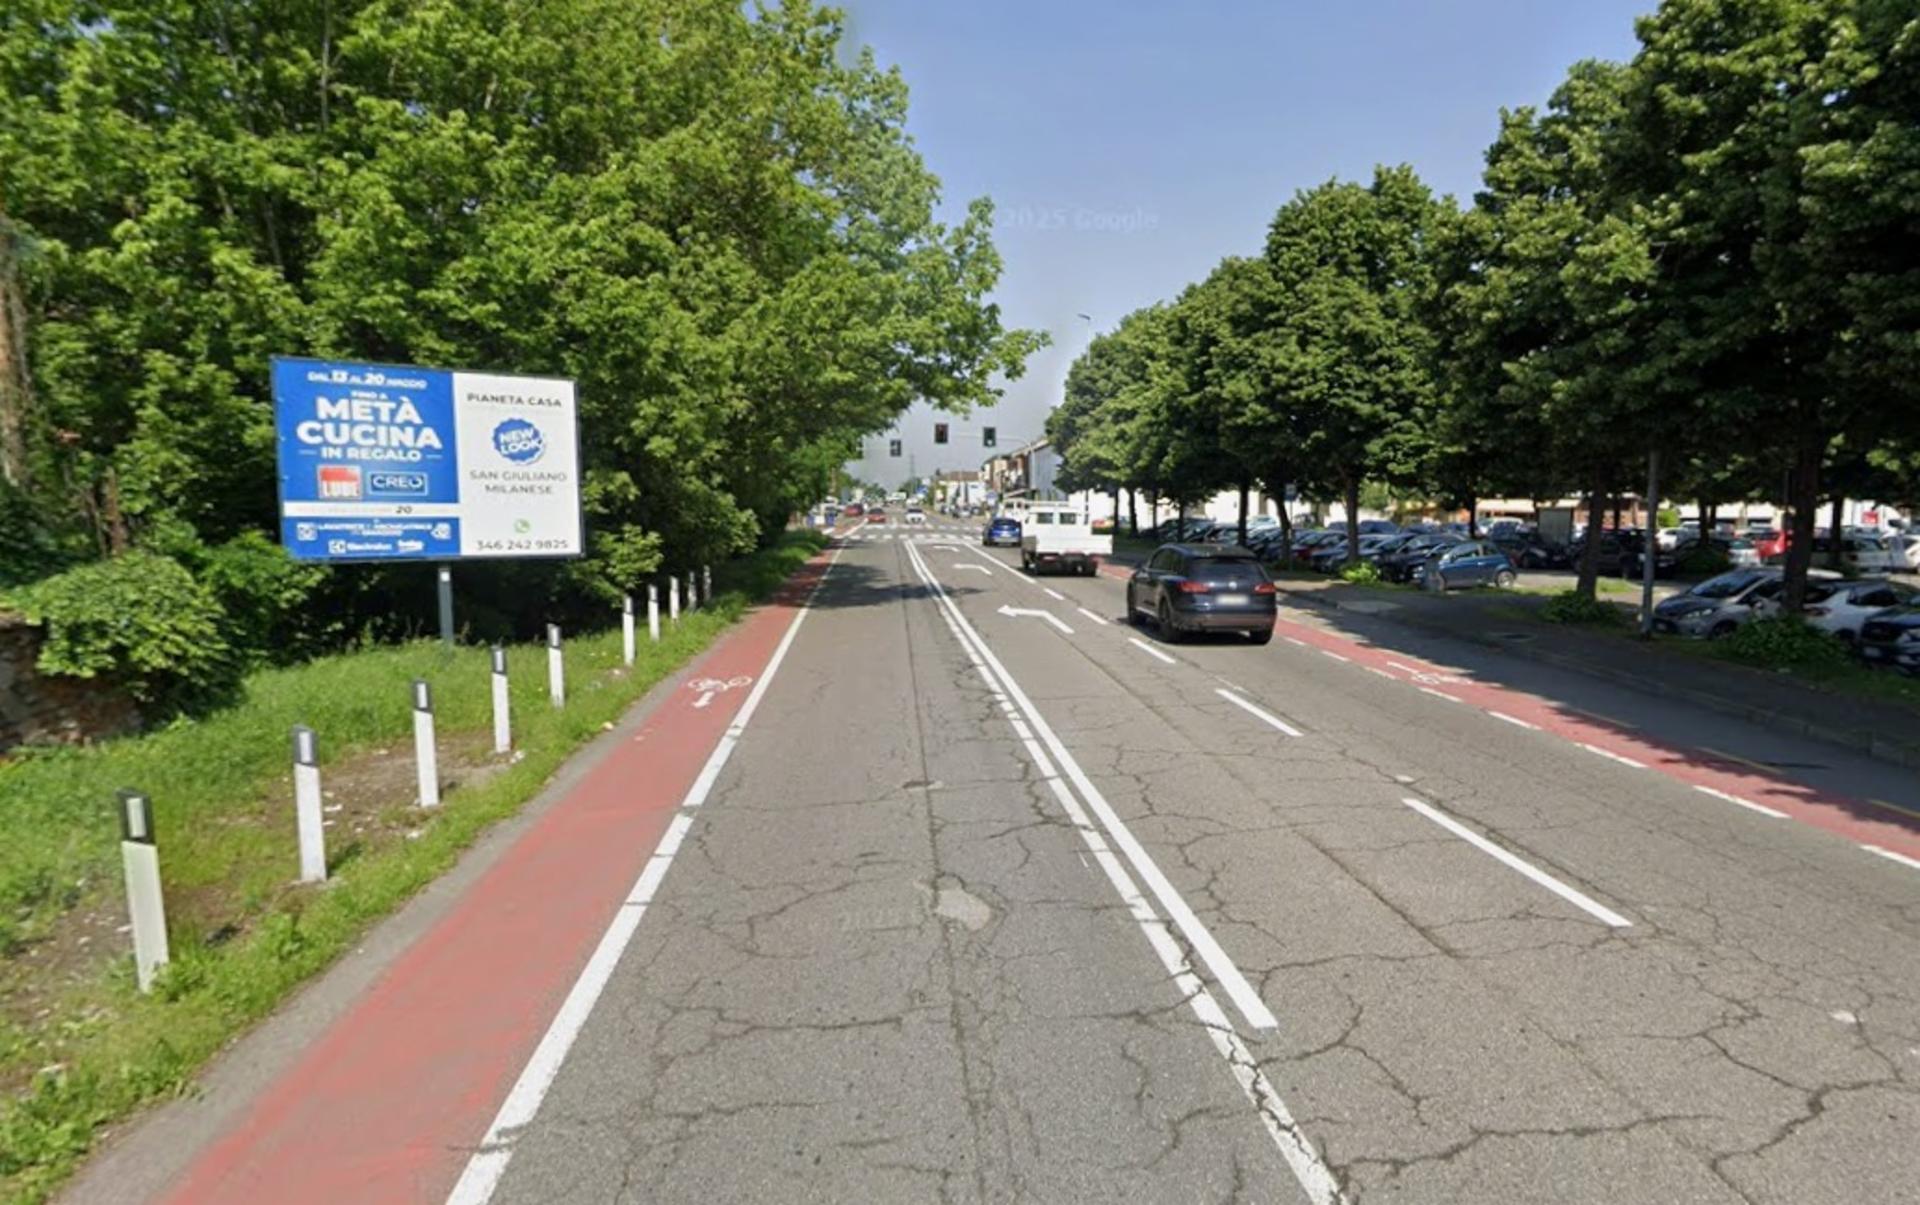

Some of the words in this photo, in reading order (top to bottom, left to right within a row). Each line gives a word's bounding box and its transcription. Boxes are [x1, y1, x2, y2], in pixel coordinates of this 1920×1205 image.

[365, 372, 386, 385] 20
[466, 393, 524, 405] PIANETA
[528, 398, 562, 407] CASA
[316, 396, 424, 424] METÀ
[296, 420, 443, 449] CUCINA
[321, 446, 343, 459] IN
[346, 448, 422, 462] REGALO
[372, 475, 423, 489] CREO
[469, 470, 499, 481] SAN
[501, 471, 567, 482] GIULIANO
[484, 484, 553, 495] MILANESE
[477, 540, 503, 550] 346
[507, 539, 532, 550] 242
[535, 539, 569, 550] 9825
